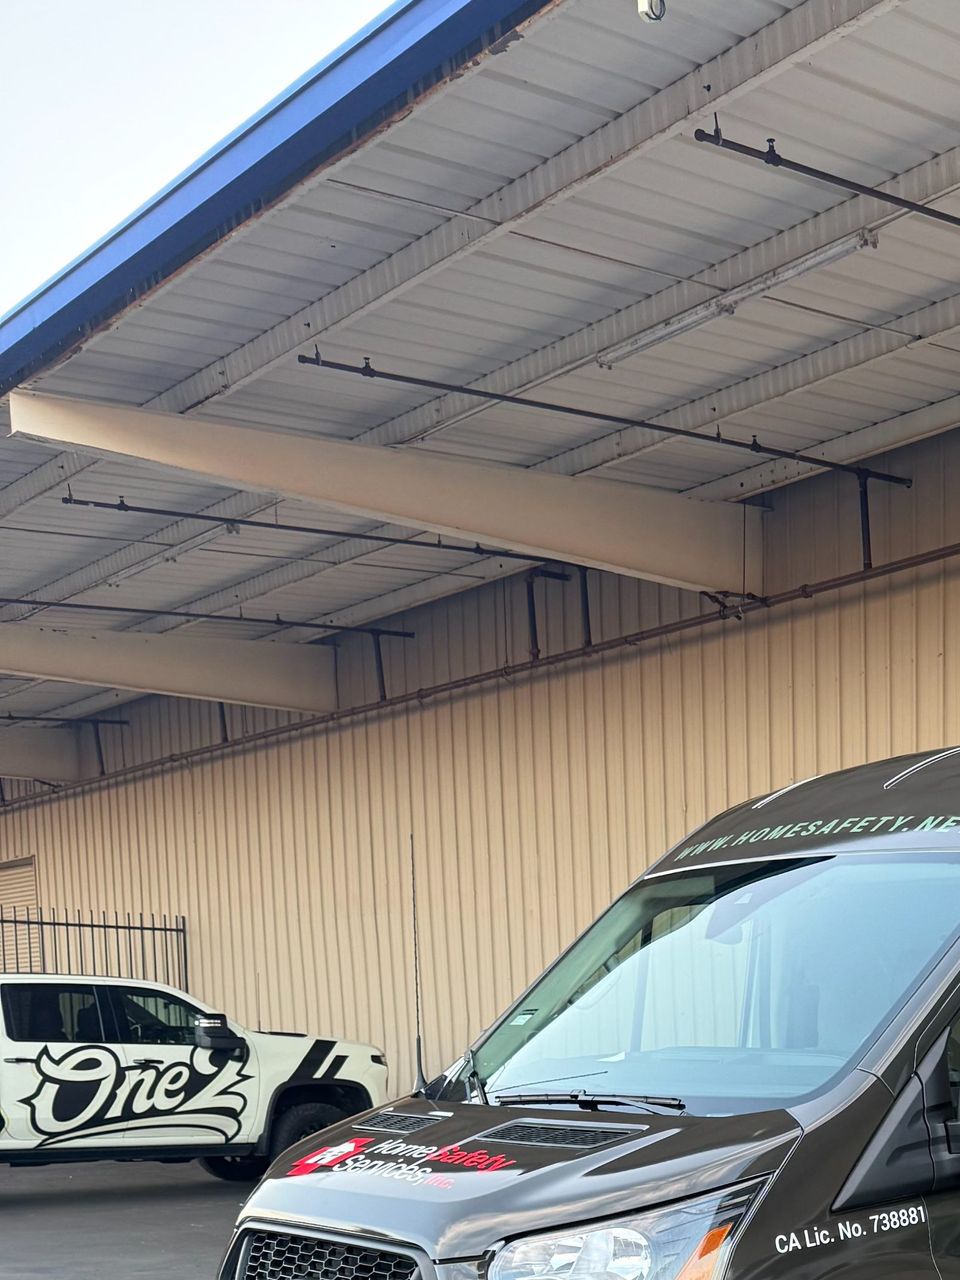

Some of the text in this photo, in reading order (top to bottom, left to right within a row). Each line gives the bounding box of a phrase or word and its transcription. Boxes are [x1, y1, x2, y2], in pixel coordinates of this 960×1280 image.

[775, 1205, 926, 1254] CA Lic. No. 738881
